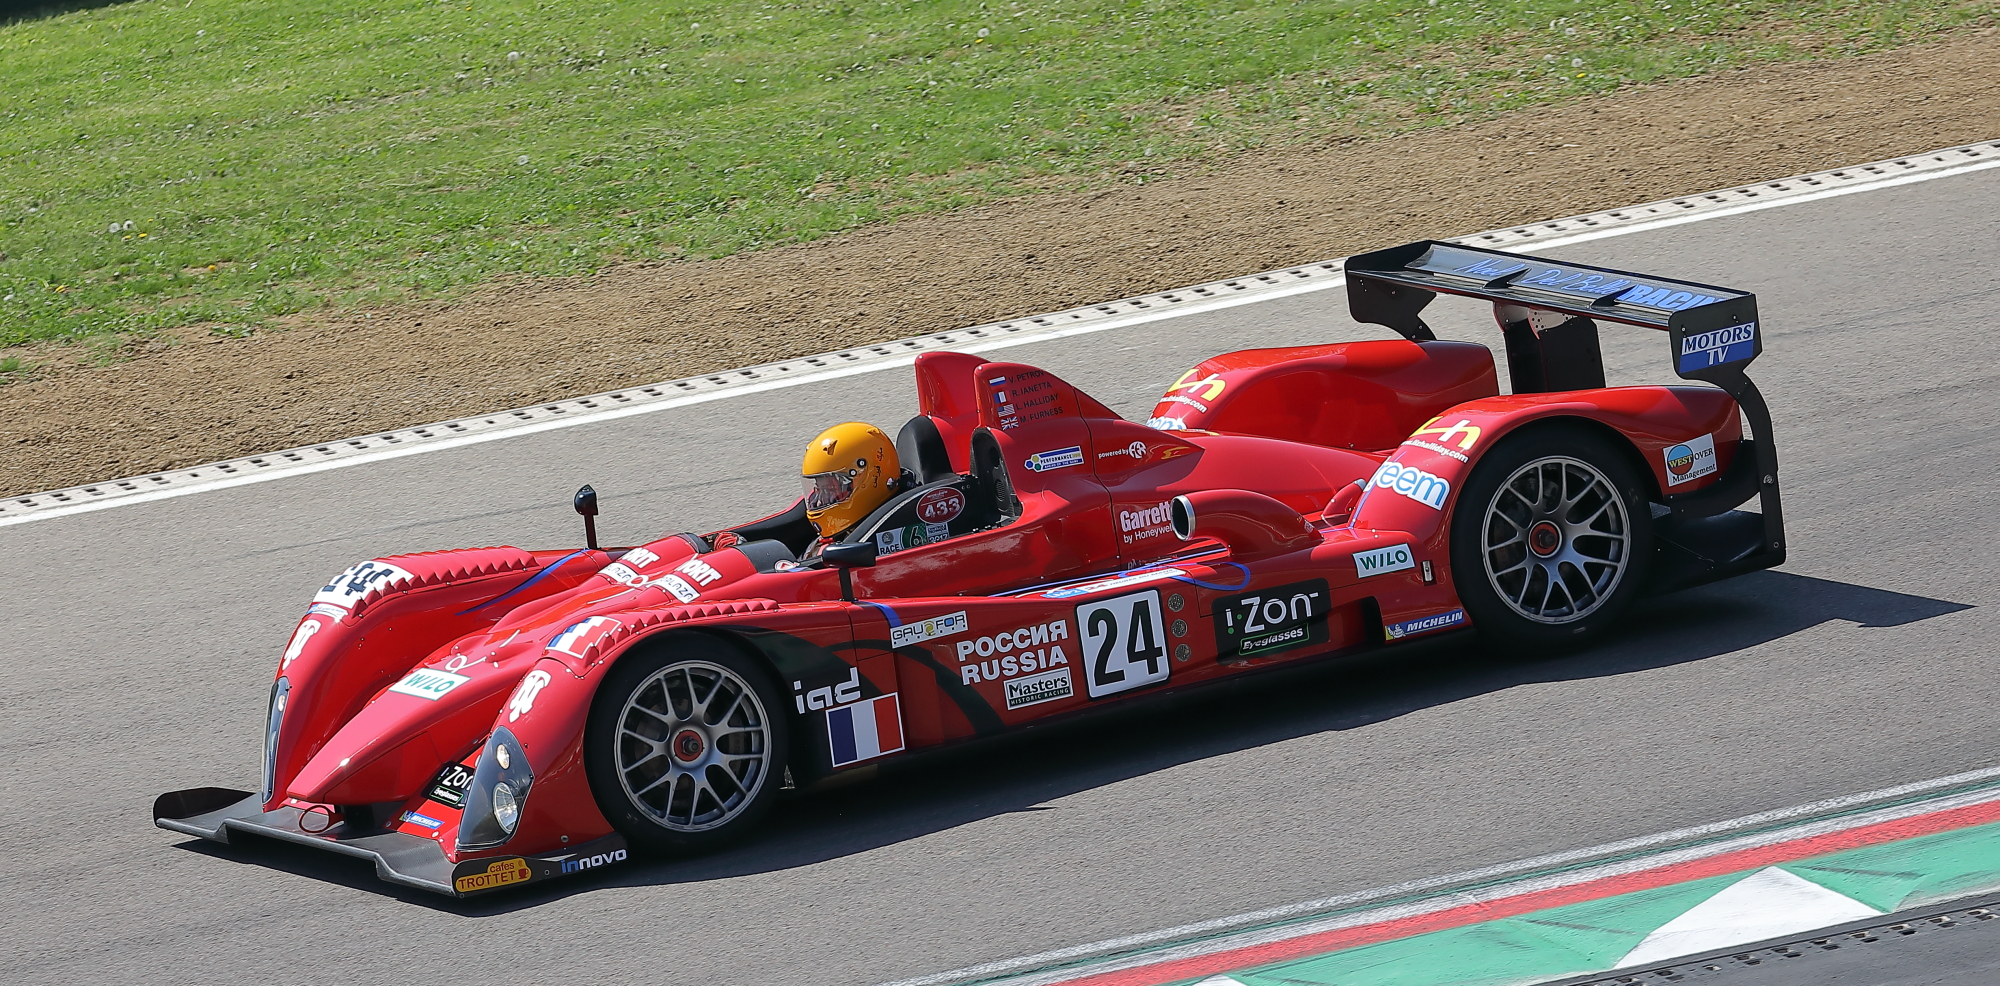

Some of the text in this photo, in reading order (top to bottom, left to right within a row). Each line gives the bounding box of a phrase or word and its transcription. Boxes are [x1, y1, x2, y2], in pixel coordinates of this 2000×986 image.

[1684, 324, 1752, 353] MOTORS
[1706, 346, 1729, 365] TV
[1016, 370, 1045, 381] PETROV
[1021, 382, 1052, 395] IANETTA
[1023, 393, 1058, 409] HALLIDAY
[1030, 406, 1063, 420] FURNESS
[1098, 448, 1122, 459] powered
[1668, 447, 1714, 469] WEST OVER
[1672, 462, 1716, 484] Management
[924, 497, 961, 518] 433
[1120, 500, 1172, 532] Garrett
[909, 525, 923, 547] 6
[1123, 523, 1174, 544] by Honeywel
[879, 543, 900, 555] RACE
[1359, 549, 1408, 570] WILO
[1406, 611, 1463, 632] MICHELIN
[956, 619, 1069, 662] РОССИЯ
[1087, 599, 1163, 687] 24
[1242, 627, 1304, 650] Eyeglasses
[961, 645, 1069, 686] RUSSIA
[404, 673, 455, 693] WILO
[1008, 675, 1068, 698] Masters
[1010, 687, 1070, 705] HISTORIC RACING
[489, 861, 515, 873] cafes
[561, 848, 628, 874] innovo
[458, 870, 516, 890] TROTTET
